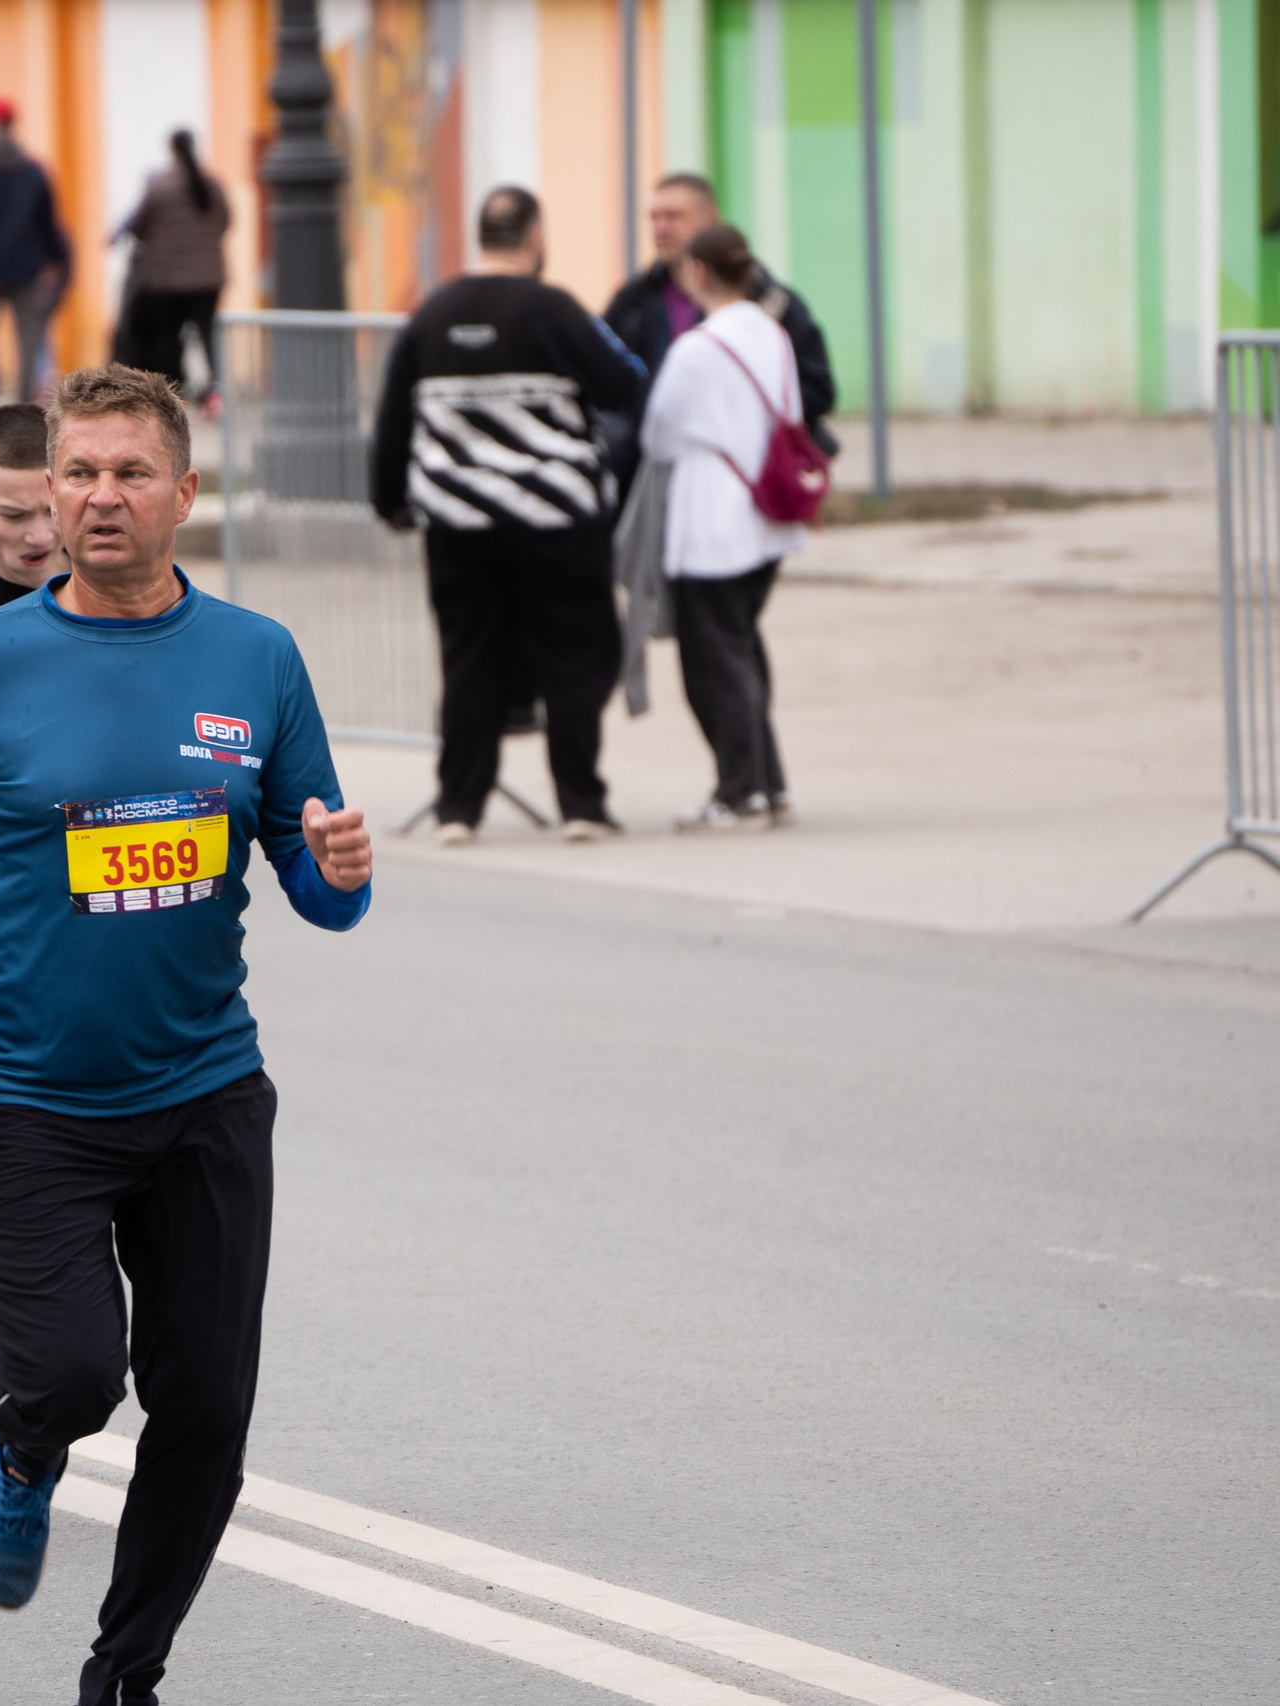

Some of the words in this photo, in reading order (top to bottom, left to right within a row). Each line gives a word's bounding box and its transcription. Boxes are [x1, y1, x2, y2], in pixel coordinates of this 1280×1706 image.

[200, 719, 245, 742] ВЭП
[114, 804, 123, 812] Я
[124, 799, 178, 811] ПРОСТО
[114, 806, 179, 820] КОСМОС
[101, 838, 199, 886] 3569
